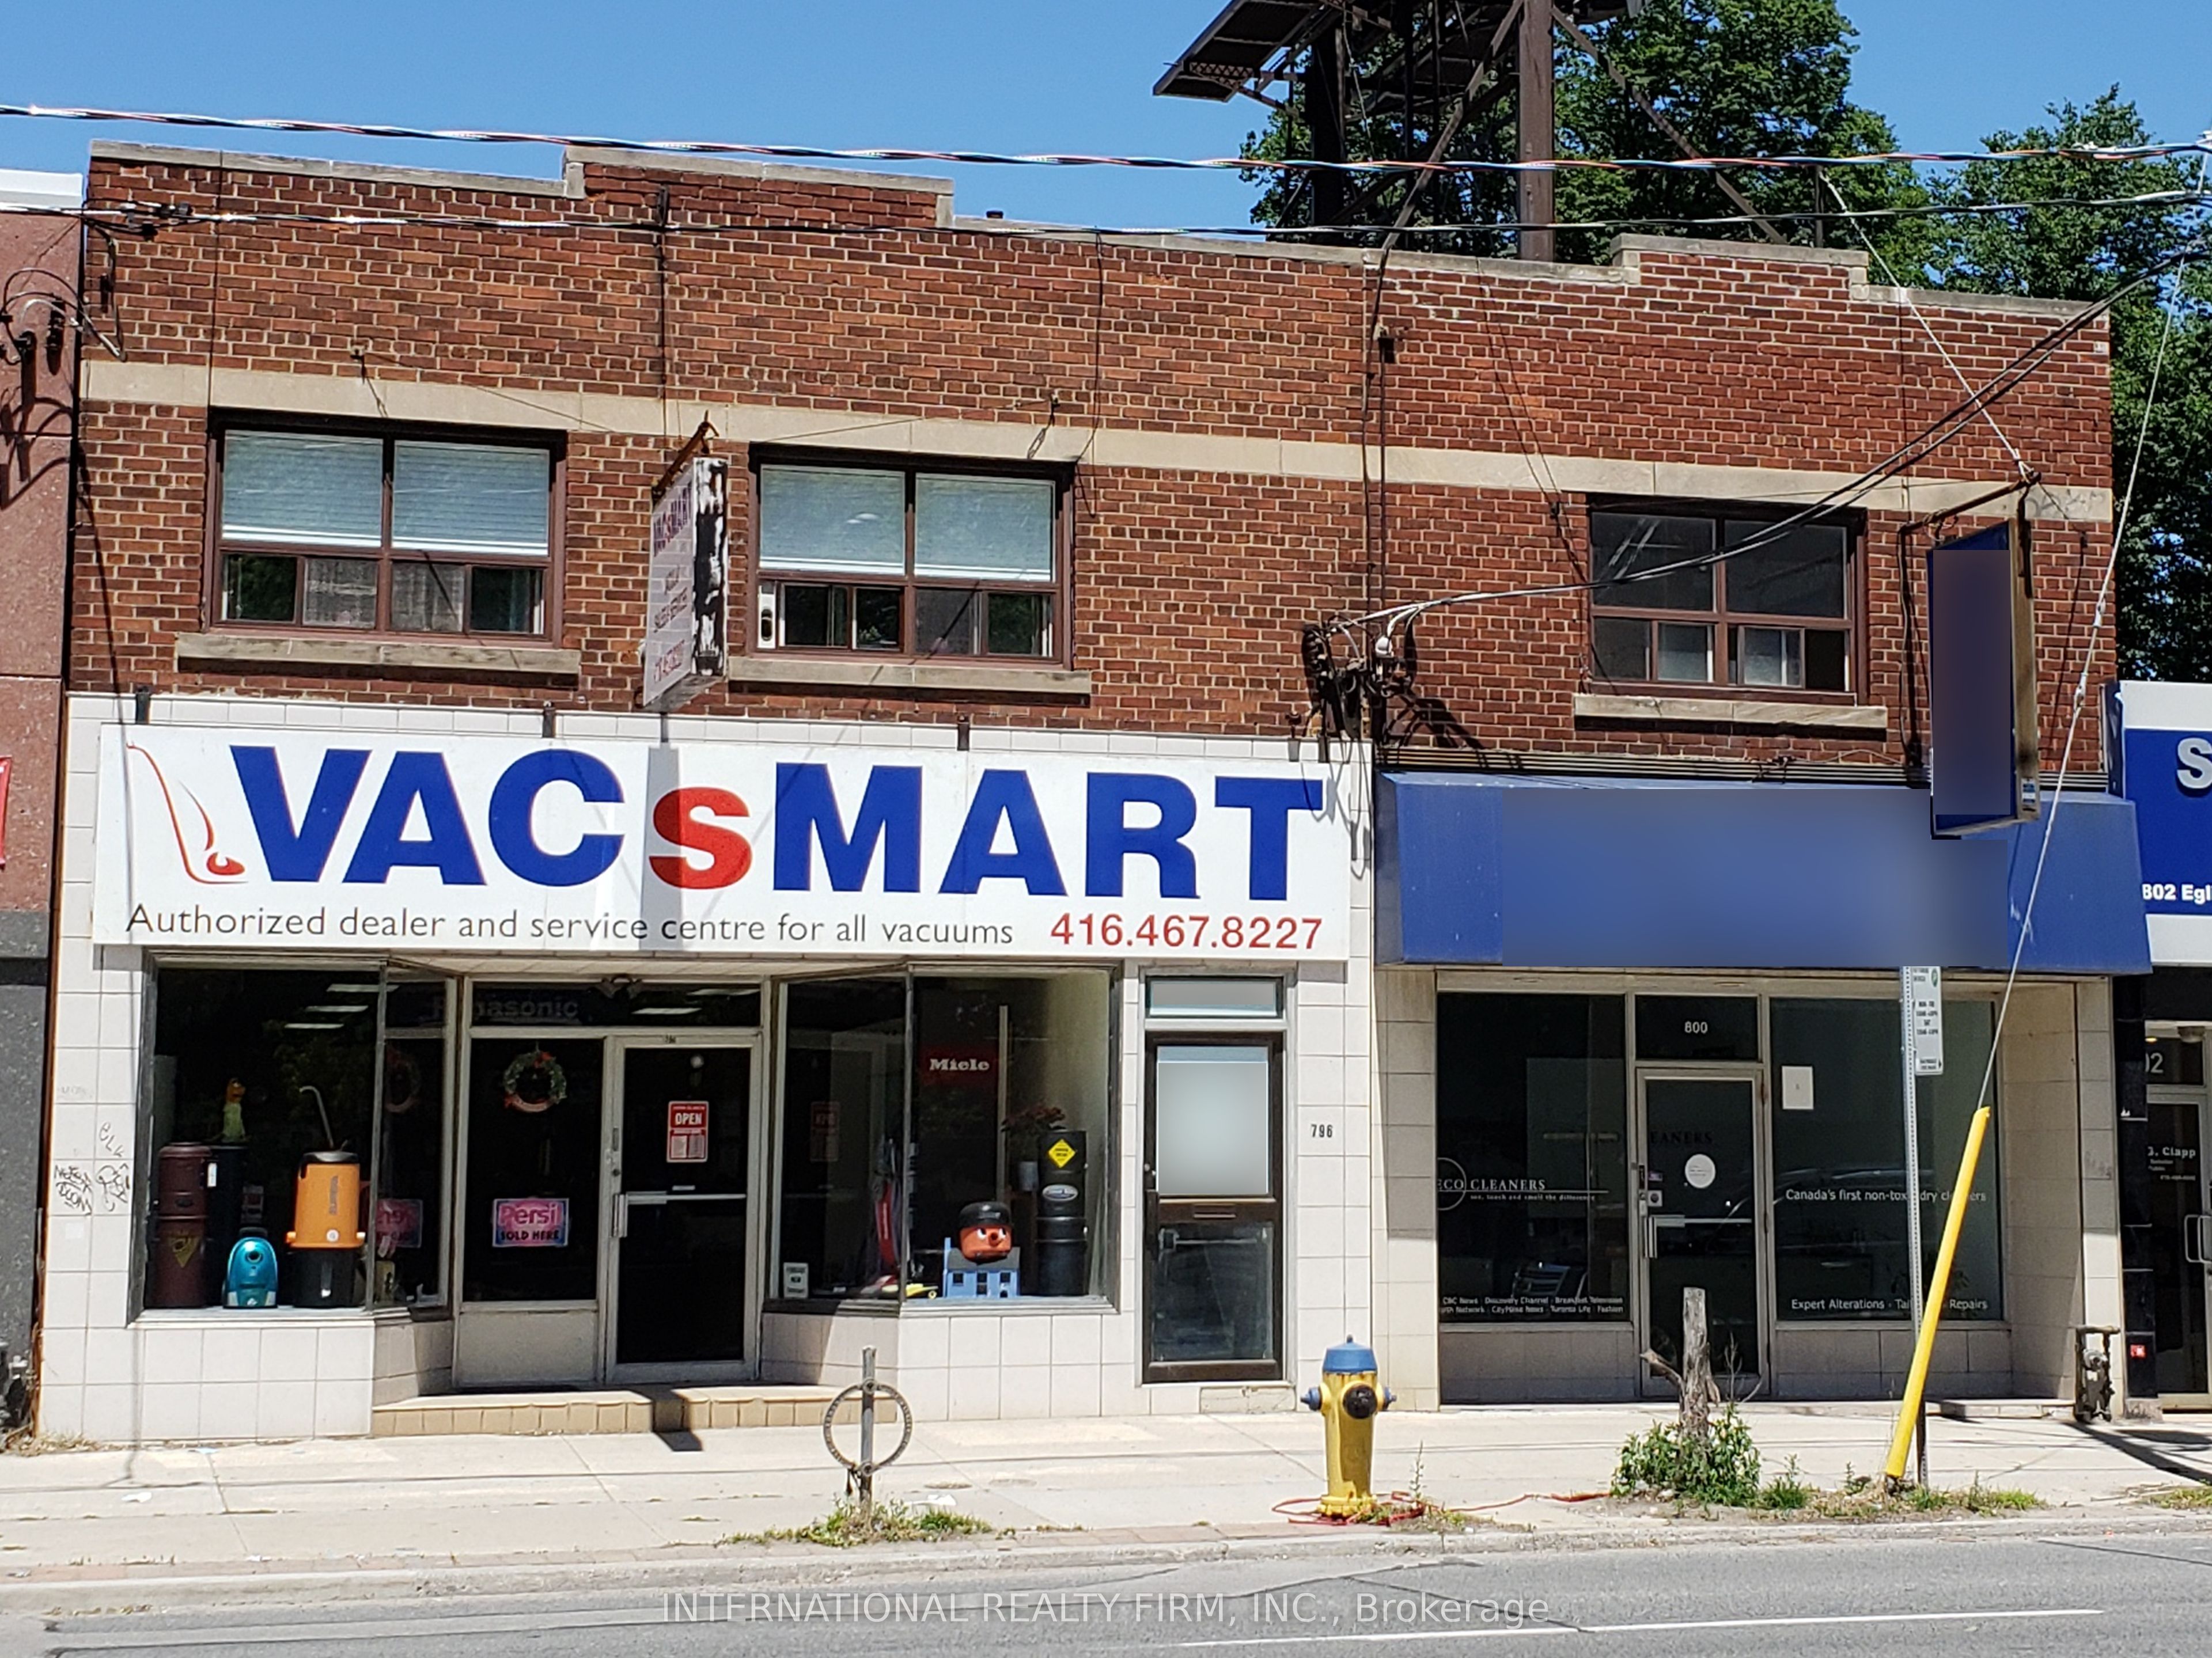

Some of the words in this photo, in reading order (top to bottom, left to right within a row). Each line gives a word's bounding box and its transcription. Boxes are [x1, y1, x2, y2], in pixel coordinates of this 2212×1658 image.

[2181, 883, 2212, 905] Egl
[126, 902, 325, 936] Authorized
[340, 906, 444, 938] dealer
[458, 908, 517, 939] and
[530, 911, 647, 940] service
[661, 917, 765, 942] centre
[778, 913, 824, 941] for
[836, 913, 866, 943] all
[881, 923, 1013, 944] vacuums
[1051, 913, 1322, 949] 416.467.8227
[1684, 1020, 1709, 1034] 800
[929, 1057, 990, 1071] Miele
[675, 1112, 702, 1125] OPEN
[1310, 1124, 1334, 1138] 796
[2162, 1147, 2196, 1159] Clapp
[1470, 1178, 1546, 1190] CLEANERS
[1786, 1189, 1836, 1200] Canada's
[1839, 1189, 1861, 1201] first
[1865, 1190, 1907, 1201] non-tox
[1920, 1190, 1938, 1202] dry
[1940, 1190, 1986, 1201] clers
[501, 1230, 529, 1240] SOLD
[532, 1230, 559, 1240] HERE
[1791, 1299, 1825, 1311] Expert
[1828, 1298, 1885, 1310] Alterations
[1949, 1299, 1988, 1311] Repairs
